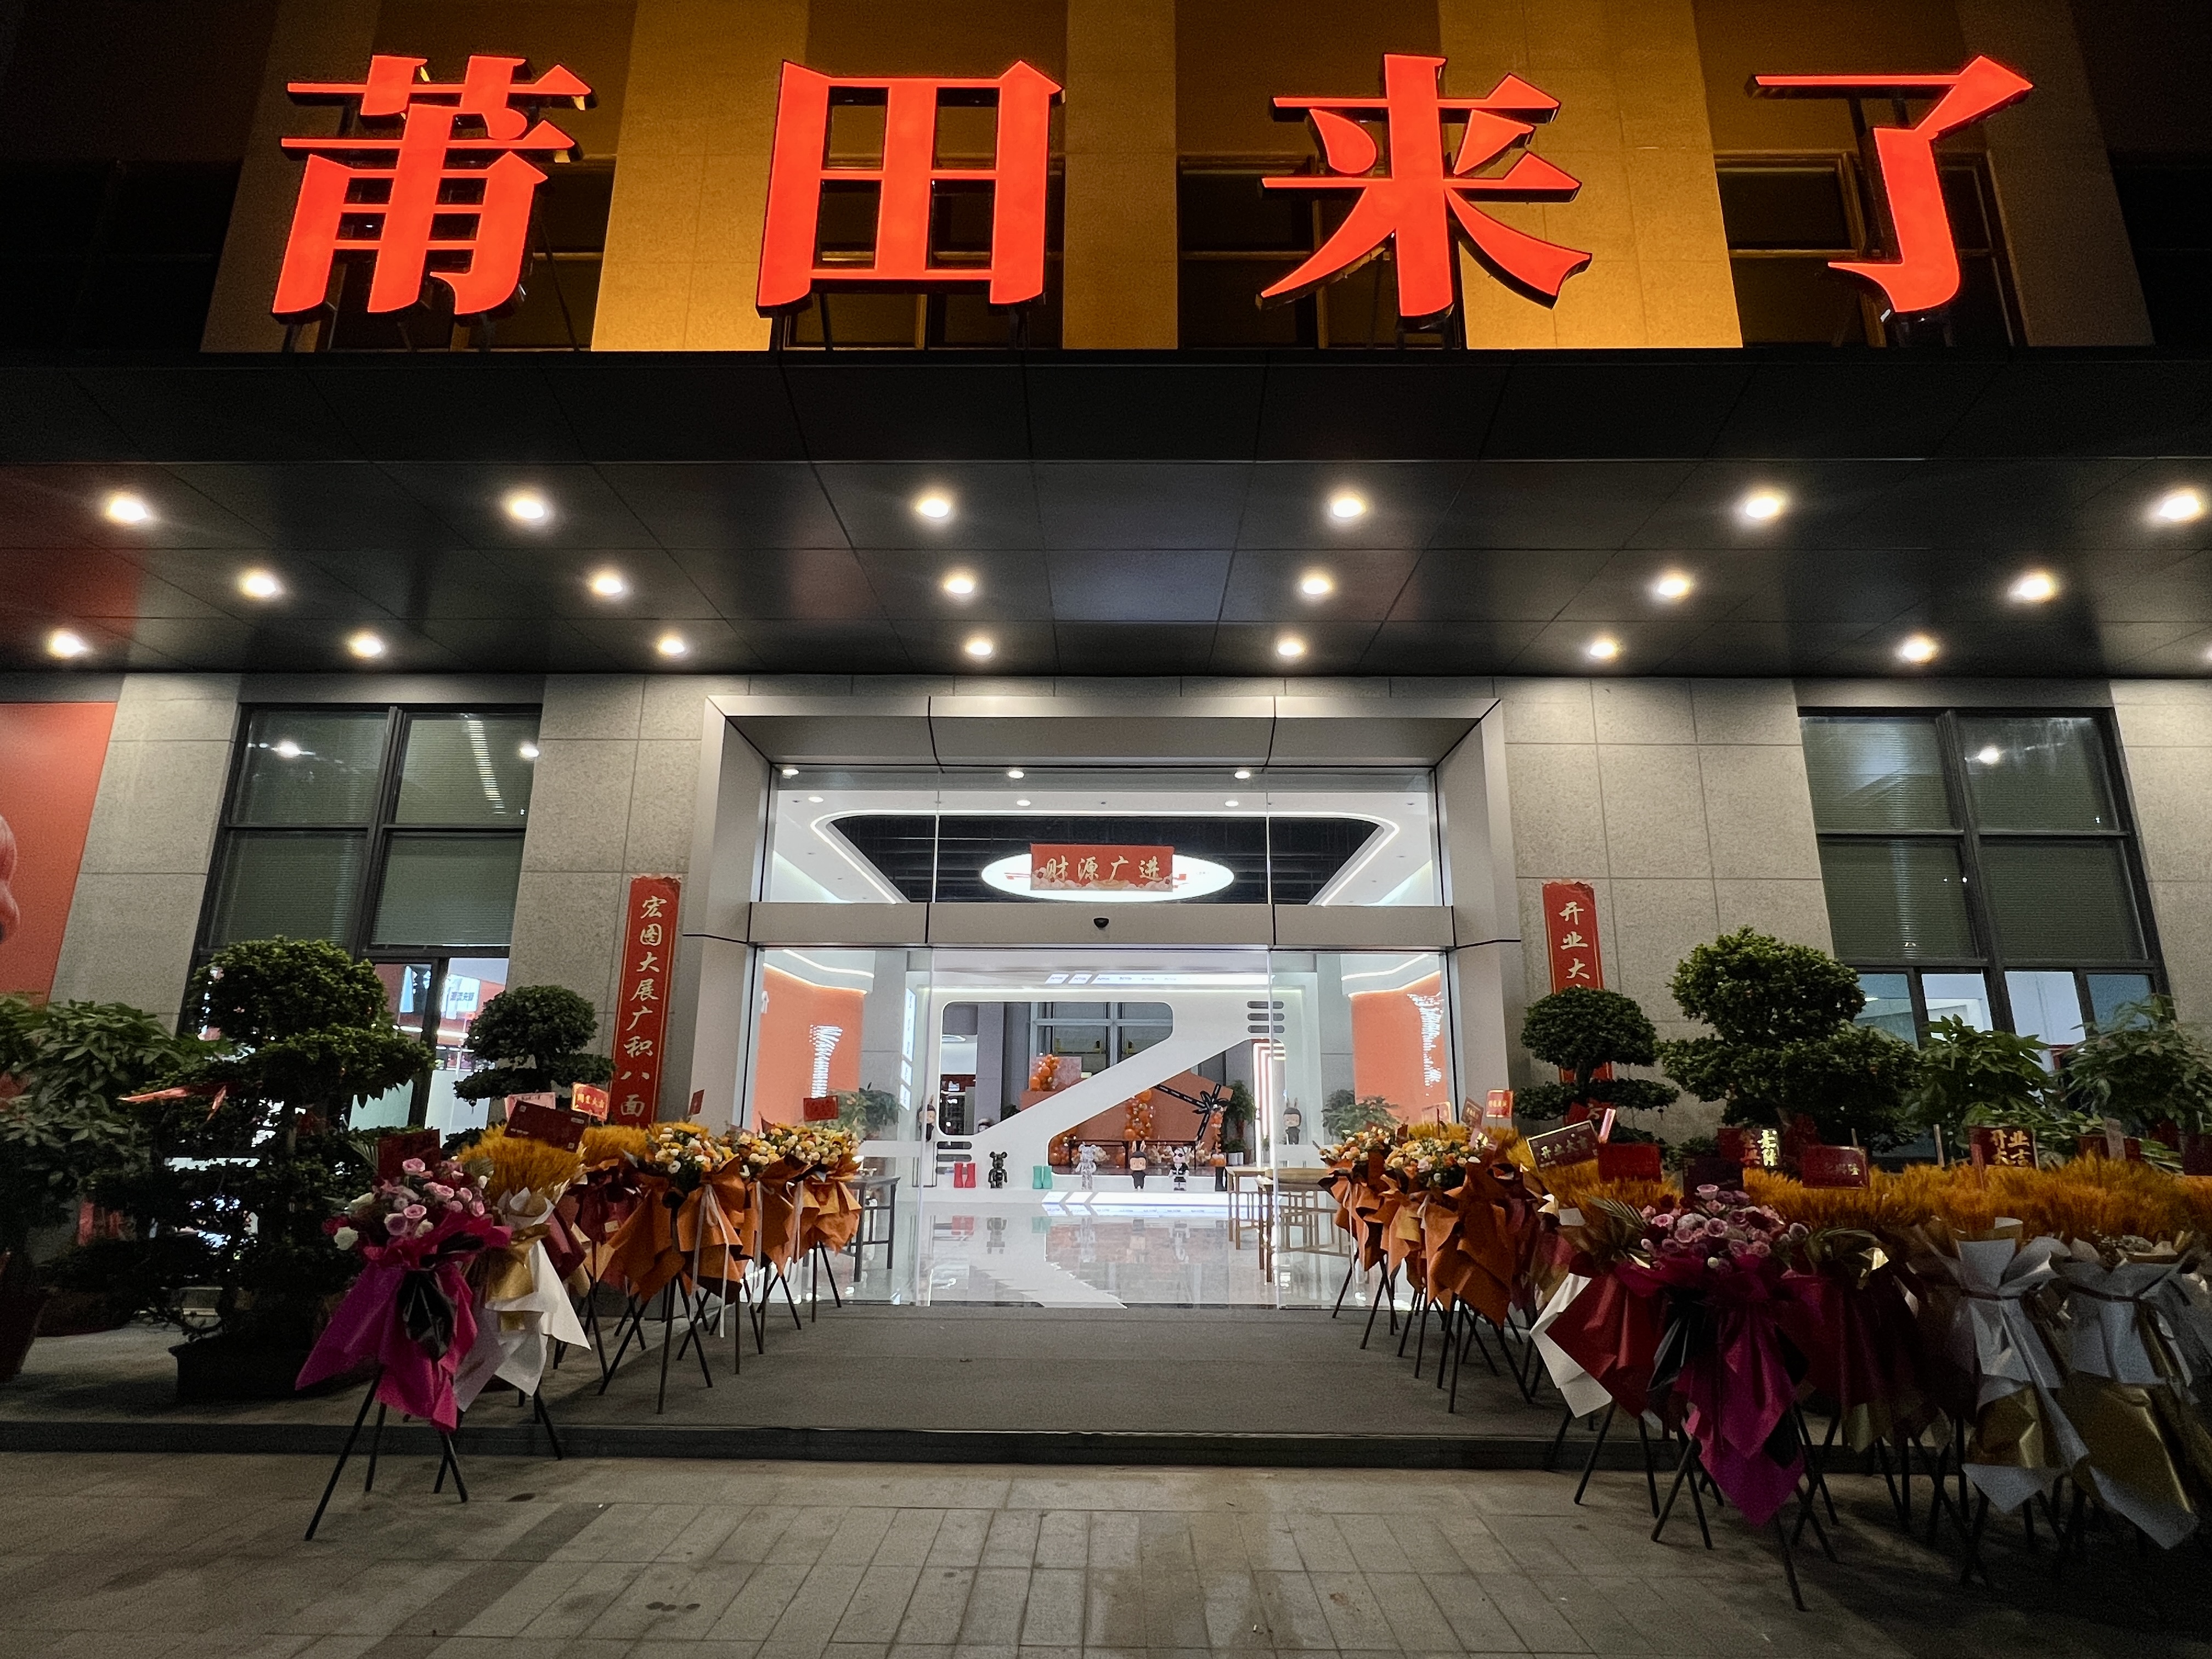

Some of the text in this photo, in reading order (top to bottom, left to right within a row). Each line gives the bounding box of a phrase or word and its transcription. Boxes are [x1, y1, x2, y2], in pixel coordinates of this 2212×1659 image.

[273, 54, 2033, 316] 莆田来了
[1046, 854, 1164, 882] 财源广进
[1559, 901, 1590, 988] 开业大
[620, 895, 668, 1127] 宏图大展广积八面
